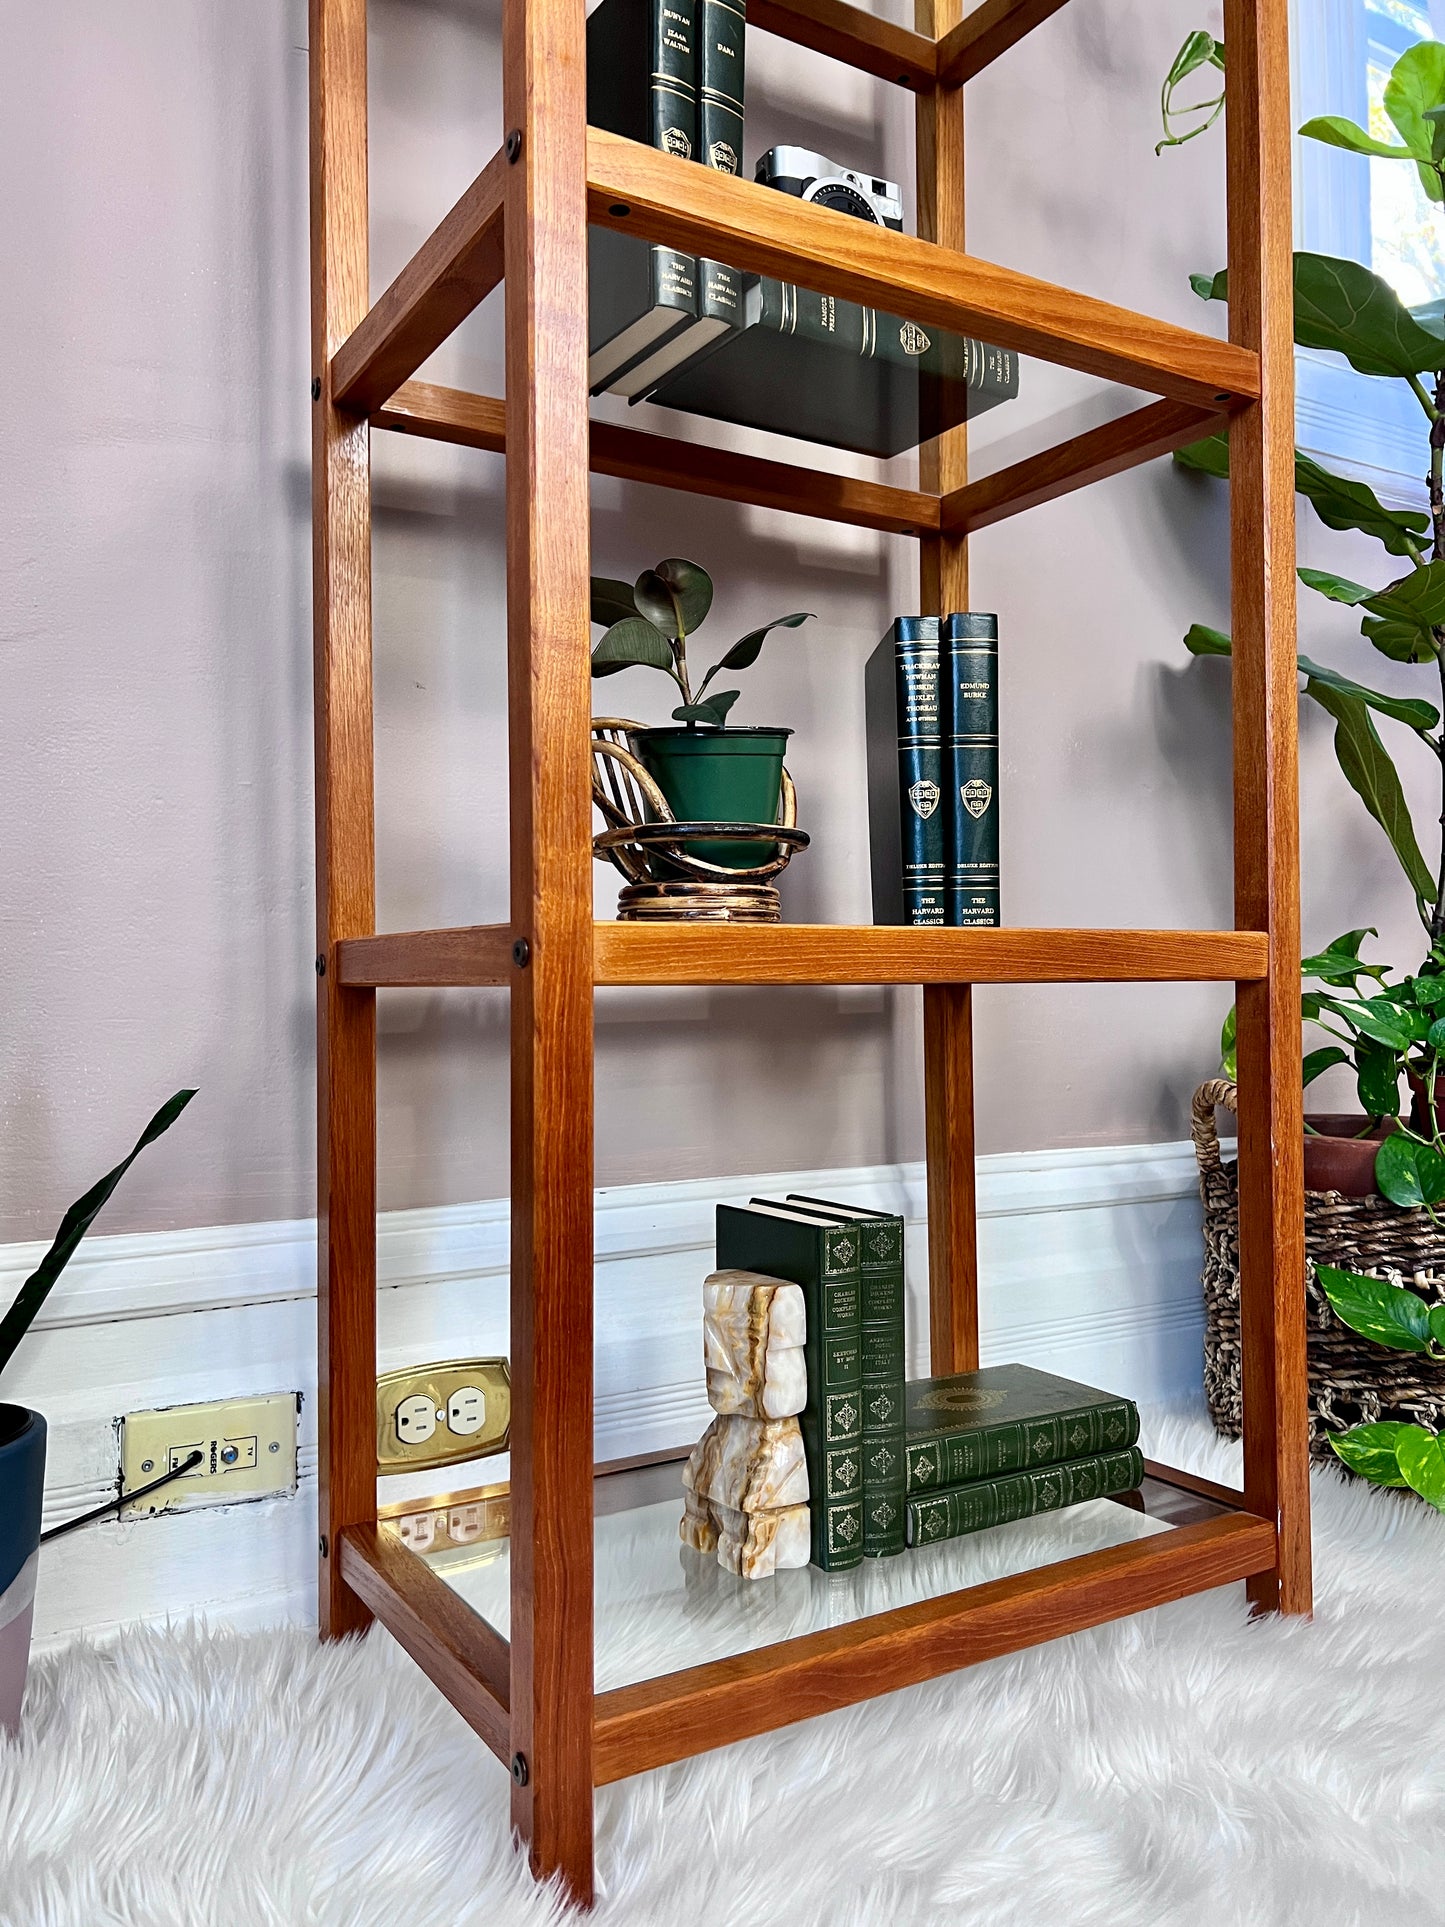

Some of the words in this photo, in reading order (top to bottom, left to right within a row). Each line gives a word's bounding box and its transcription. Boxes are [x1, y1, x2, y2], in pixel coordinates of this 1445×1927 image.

[663, 8, 690, 26] BUNYAN
[663, 37, 690, 54] WALTON
[717, 43, 735, 57] DANA
[671, 261, 686, 272] THE
[661, 272, 693, 286] HARVARD
[717, 272, 731, 282] THE
[662, 283, 692, 298] CLASSICS
[708, 281, 737, 296] HARVARD
[709, 293, 736, 308] CLASSICS
[900, 662, 940, 671] THACKERAY
[908, 683, 935, 691] RUSKIN
[960, 682, 990, 690] EDMUND
[908, 694, 935, 702] HUXLEY
[963, 691, 987, 699] BURKE
[906, 704, 938, 712] THOREAU
[912, 907, 945, 915] HARVARD
[962, 907, 995, 915] HARVARD
[247, 1446, 253, 1456] TV
[210, 1440, 218, 1474] ROGERS
